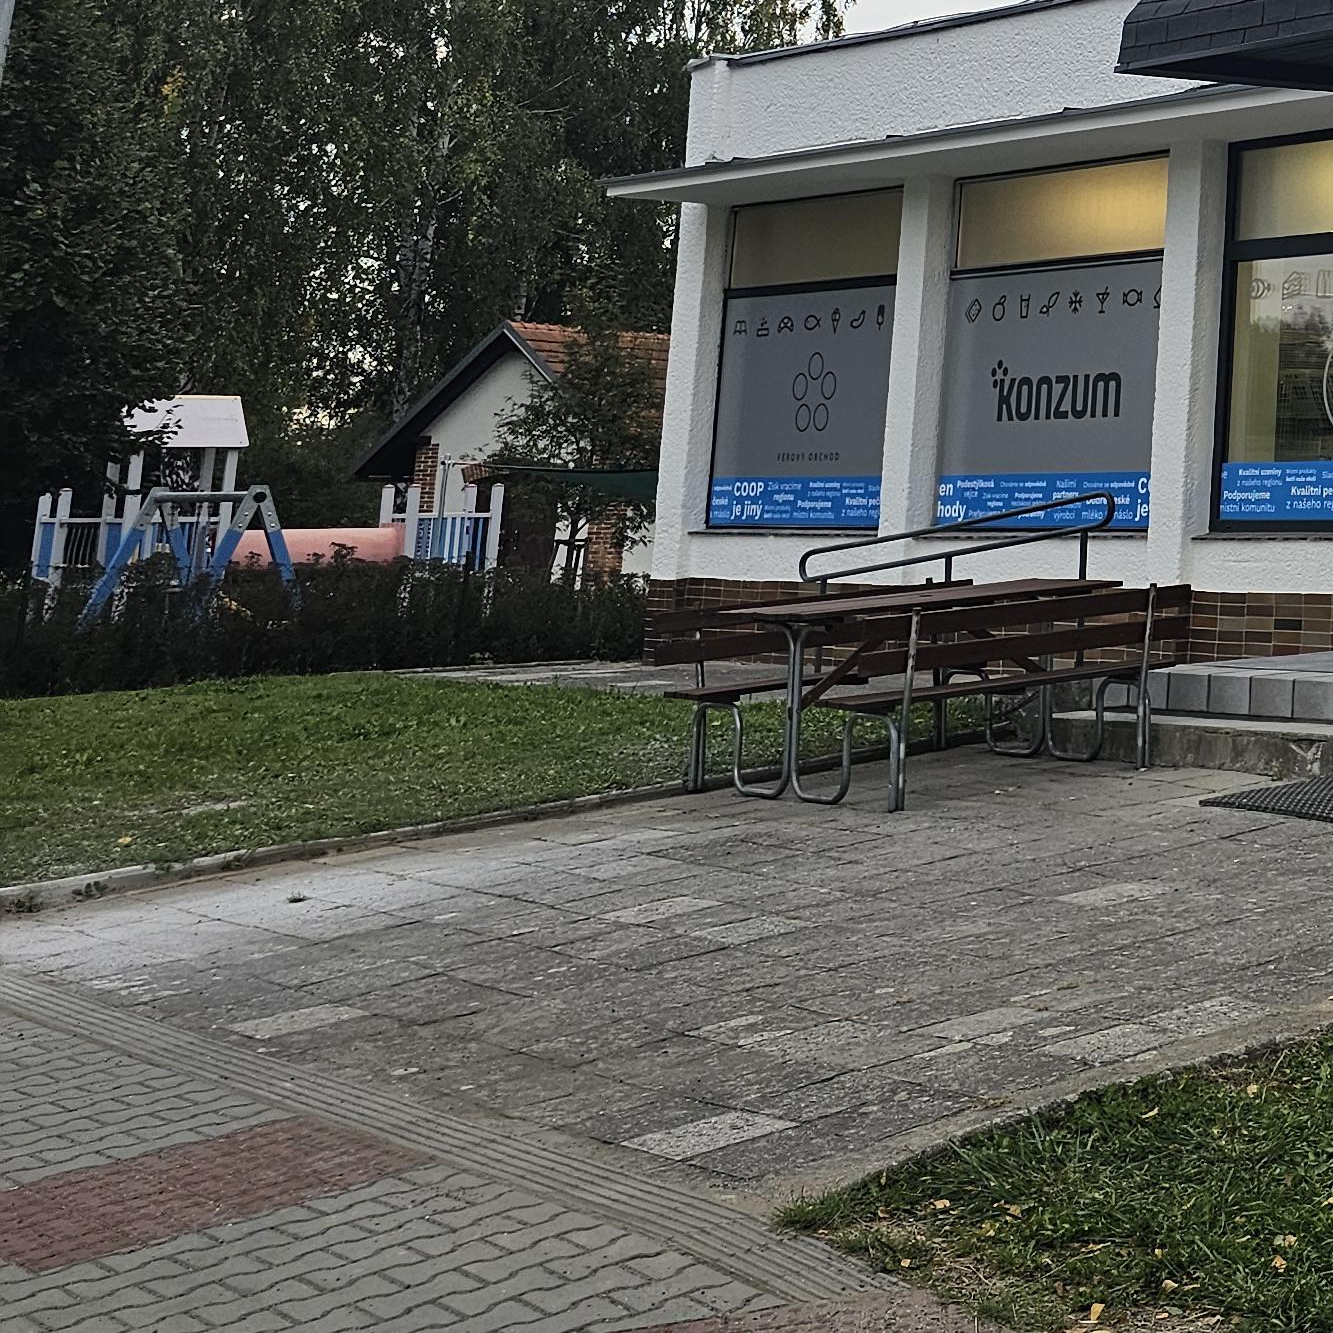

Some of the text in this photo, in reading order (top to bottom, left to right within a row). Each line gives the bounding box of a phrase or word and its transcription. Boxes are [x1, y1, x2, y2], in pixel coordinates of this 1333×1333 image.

[734, 482, 764, 497] COOP
[1223, 489, 1271, 502] Podporujeme
[1291, 484, 1322, 496] Kvalitní
[731, 500, 742, 520] je
[742, 500, 763, 520] jiný
[1286, 501, 1291, 509] z
[1292, 498, 1322, 509] našeho
[937, 500, 967, 522] hody
